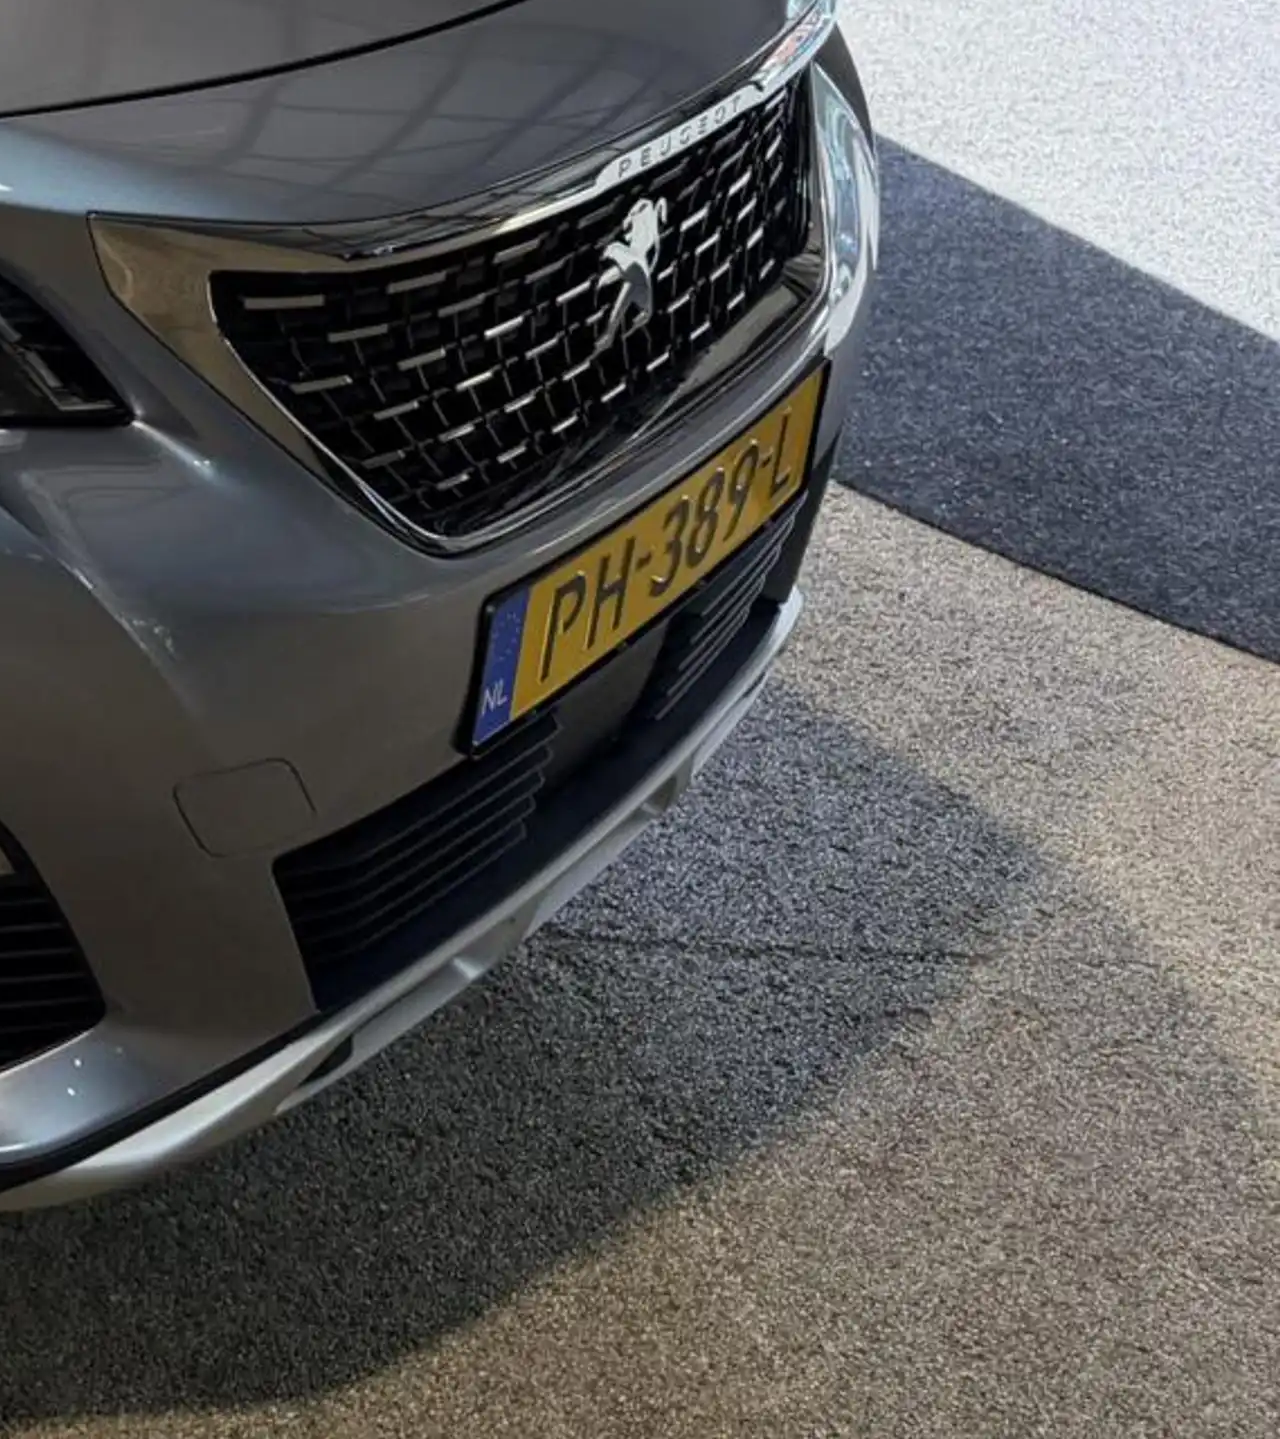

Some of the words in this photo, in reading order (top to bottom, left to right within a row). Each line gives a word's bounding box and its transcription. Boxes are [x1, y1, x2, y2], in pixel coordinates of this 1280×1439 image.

[618, 96, 742, 179] PEUGEOT
[539, 406, 793, 684] PH-389-L
[481, 682, 508, 717] NL
